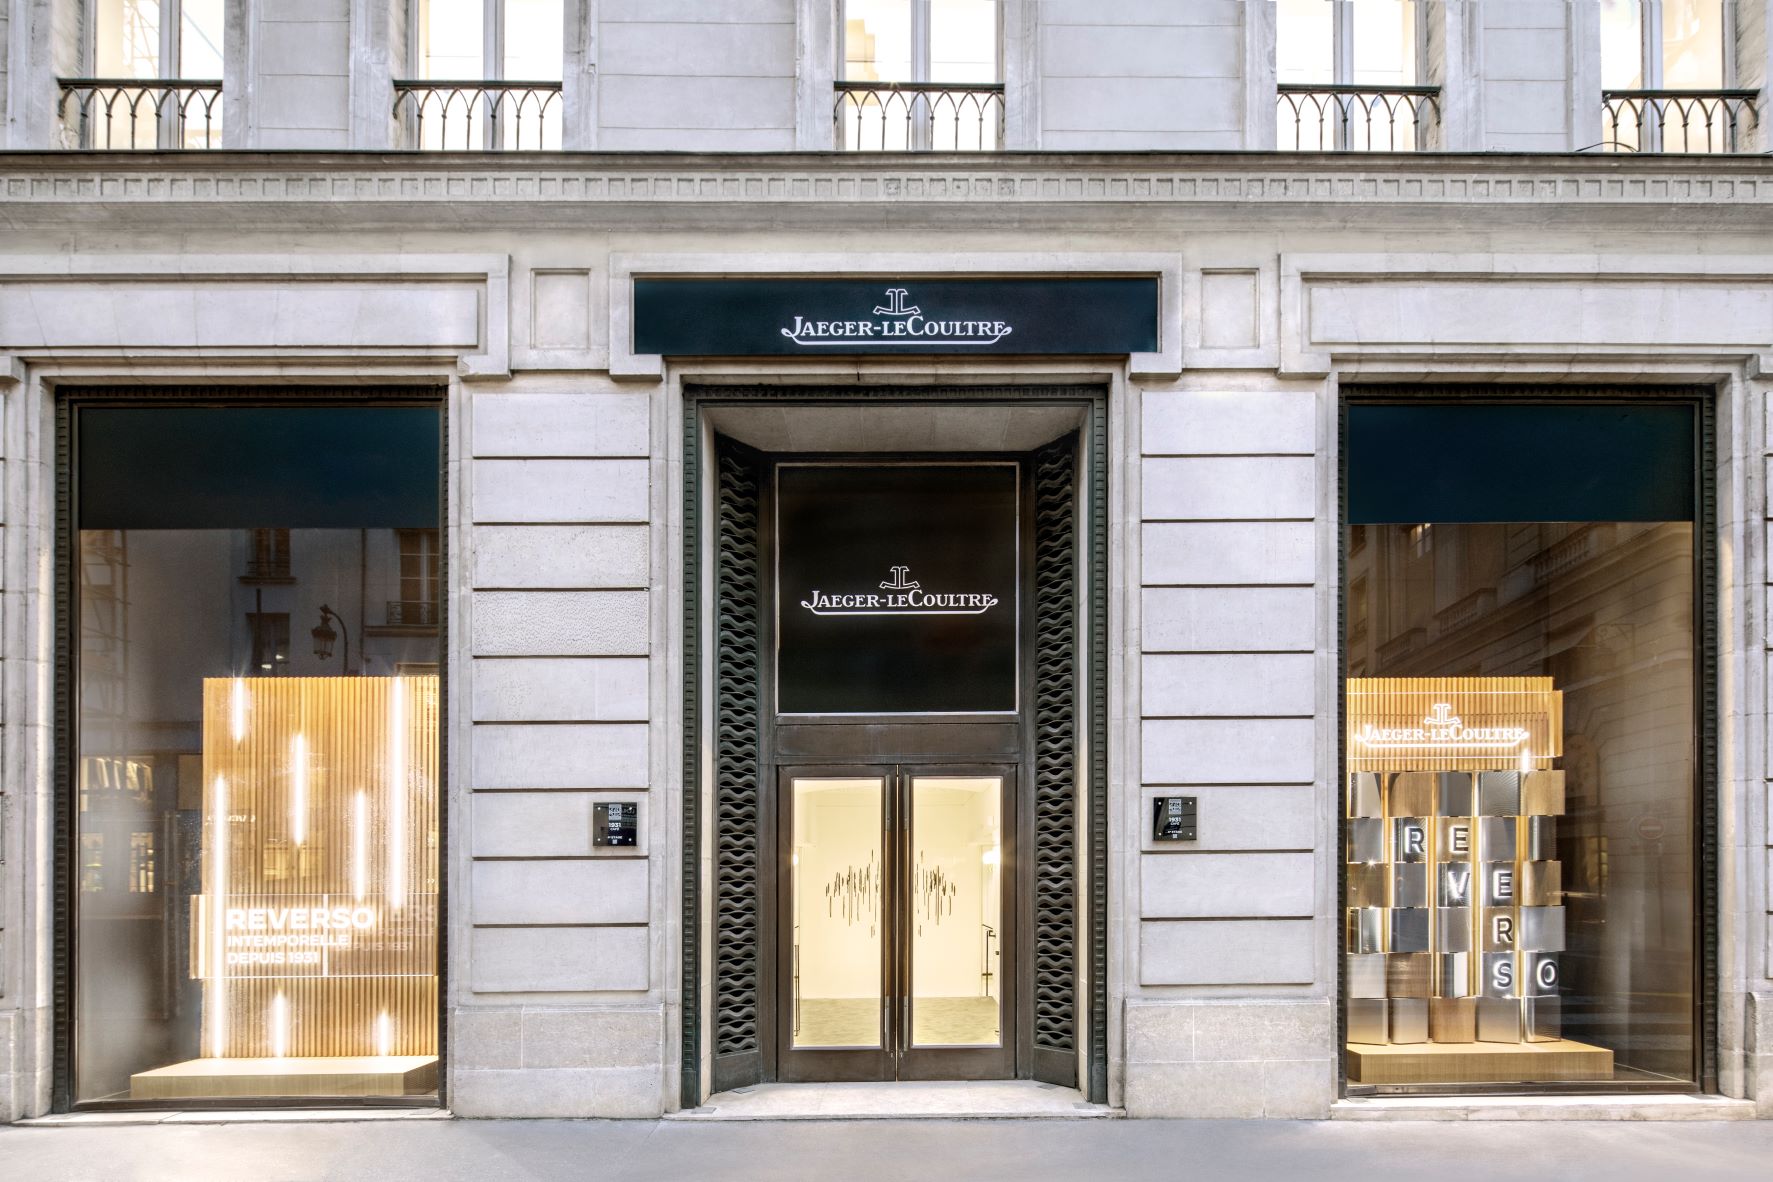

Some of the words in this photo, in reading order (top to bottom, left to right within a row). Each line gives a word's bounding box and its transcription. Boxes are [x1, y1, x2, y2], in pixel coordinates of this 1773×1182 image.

[225, 908, 375, 930] REVERSO
[227, 935, 349, 947] INTEMPORELLE
[227, 952, 285, 965] DEPUIS
[287, 951, 319, 964] 1931
